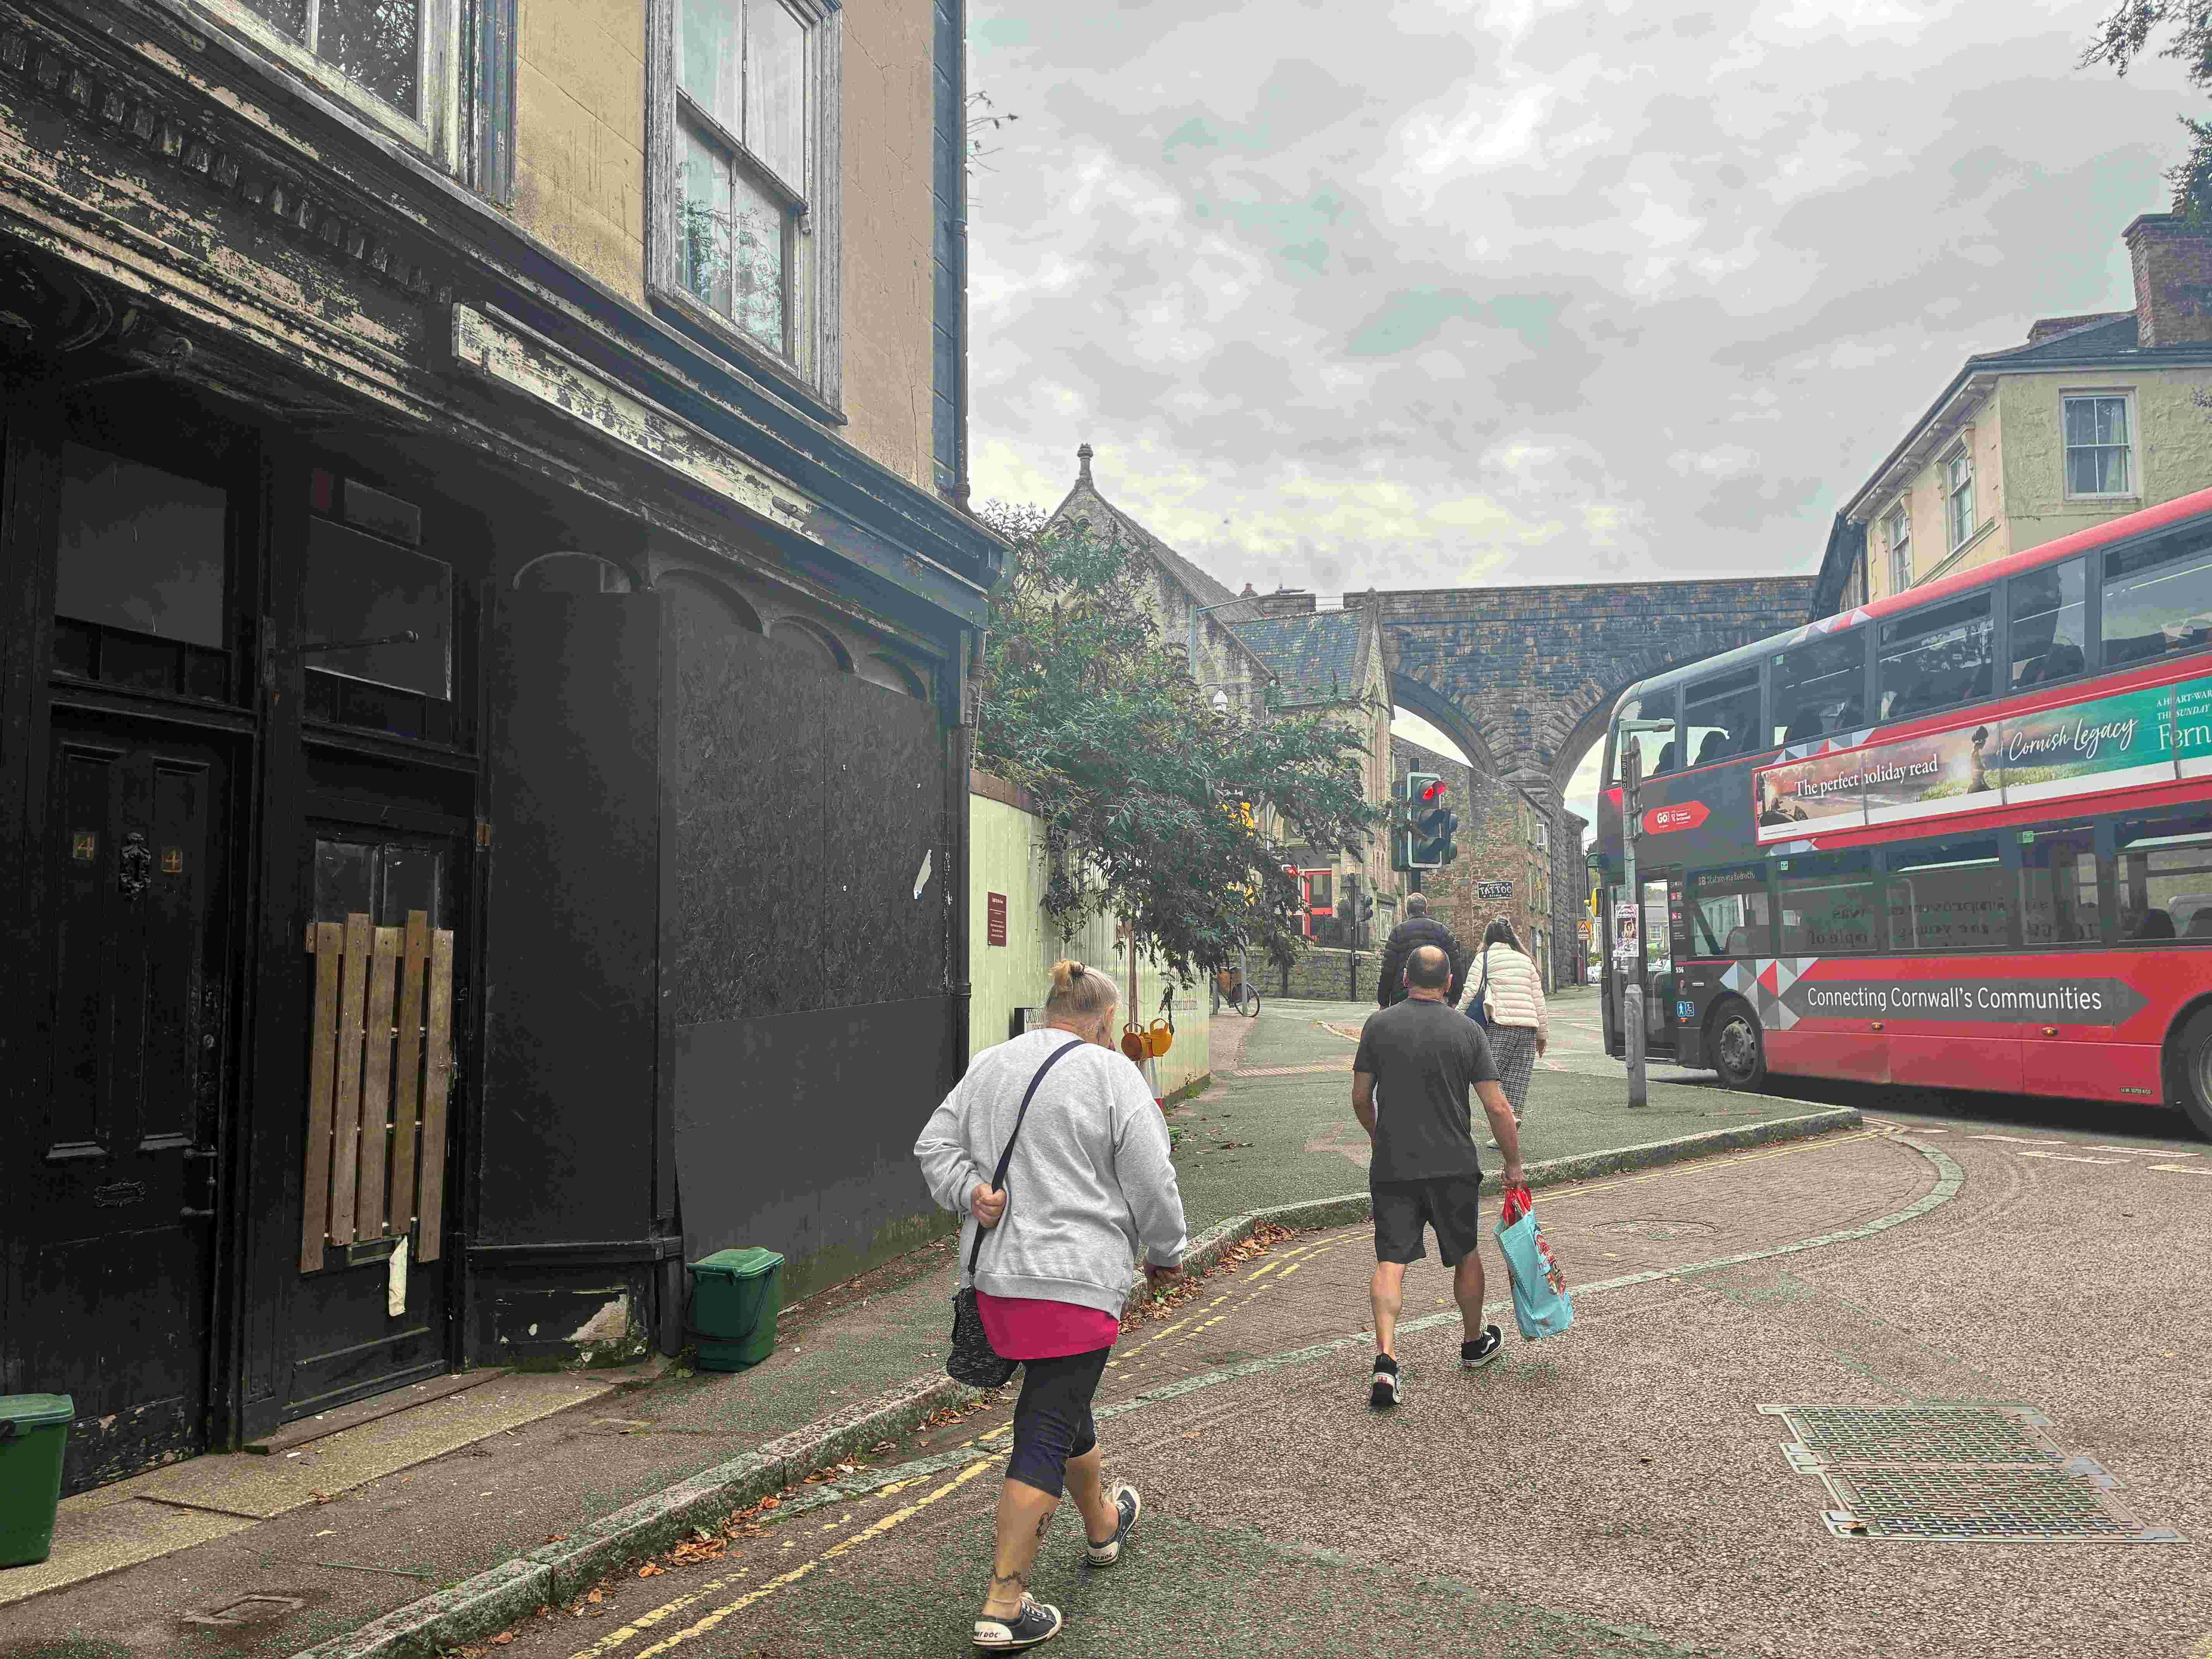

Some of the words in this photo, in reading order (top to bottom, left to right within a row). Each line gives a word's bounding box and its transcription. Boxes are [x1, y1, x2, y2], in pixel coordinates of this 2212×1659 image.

[2176, 703, 2210, 717] SUNDAY
[2009, 725, 2070, 761] Cornish
[2073, 718, 2139, 759] Legacy
[2158, 723, 2211, 750] Fern
[1794, 779, 1818, 797] The
[1820, 771, 1859, 797] perfect
[1910, 753, 1939, 776] read
[1480, 886, 1512, 895] TATTOO
[1808, 987, 1887, 1012] Connecting
[1891, 987, 1973, 1008] Cornwall’s
[1977, 987, 2102, 1010] Communities
